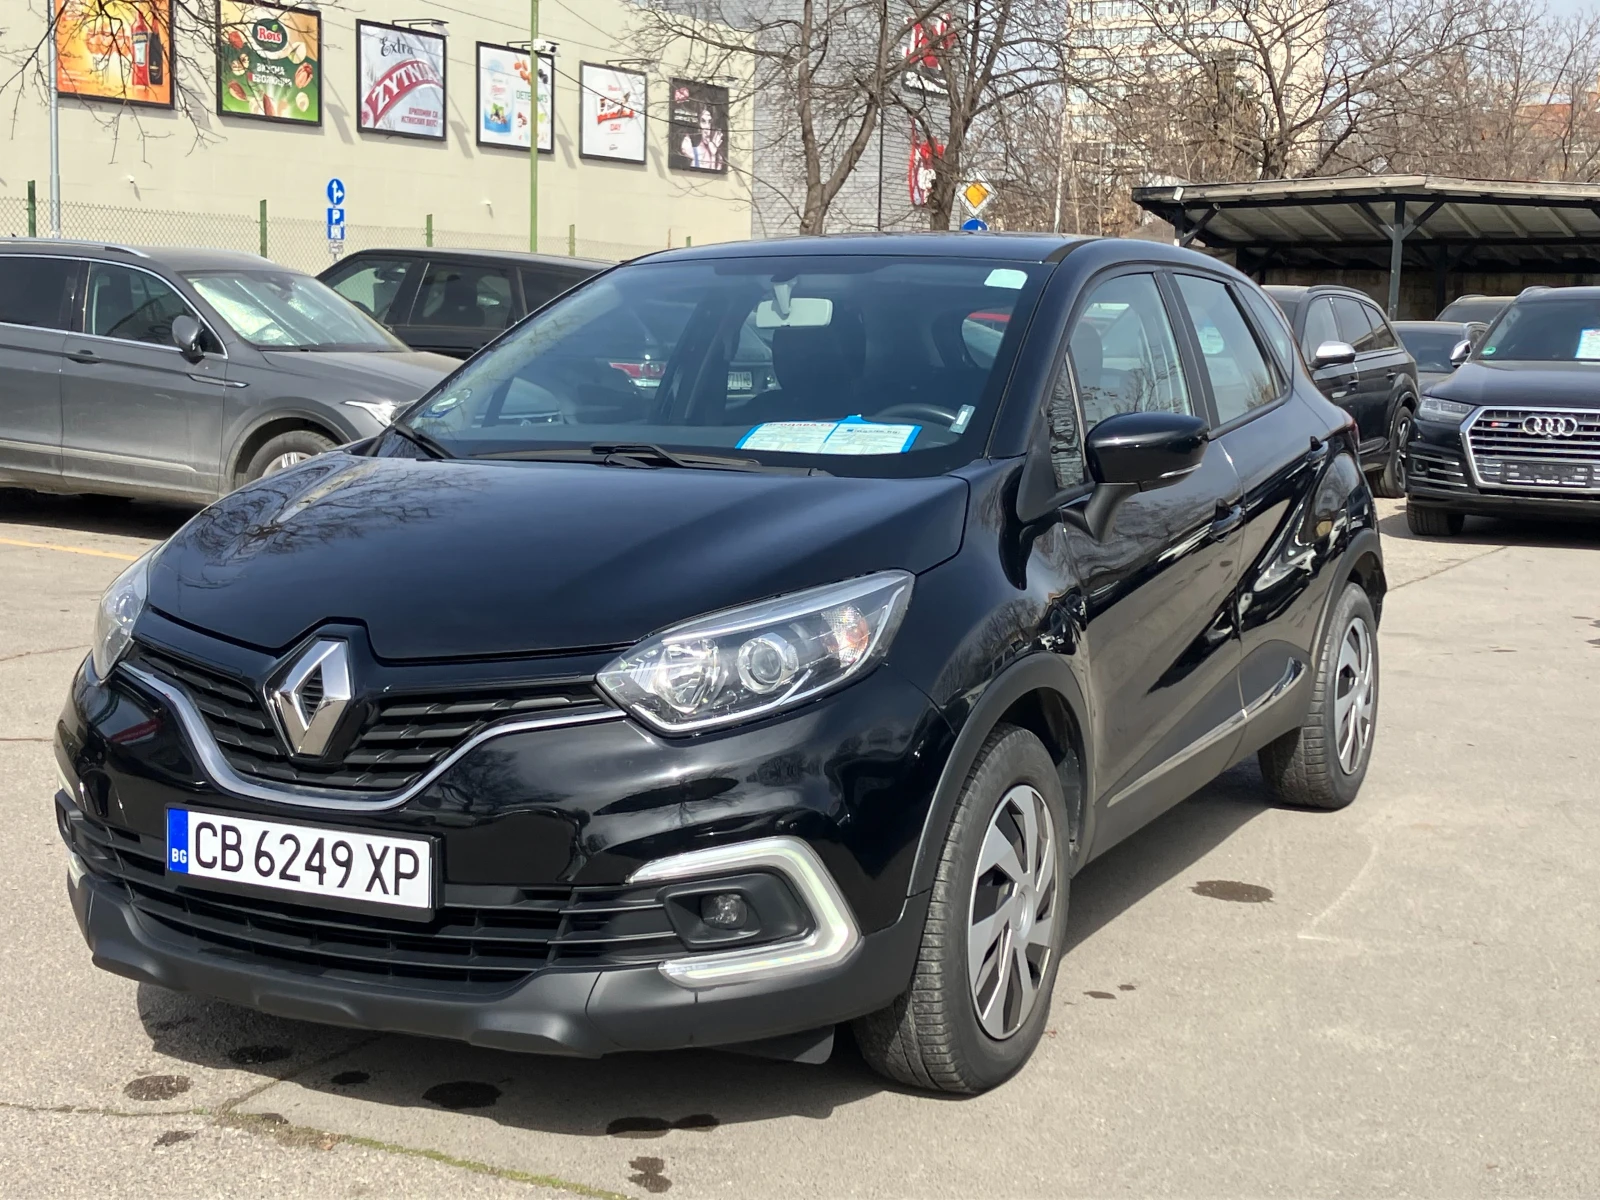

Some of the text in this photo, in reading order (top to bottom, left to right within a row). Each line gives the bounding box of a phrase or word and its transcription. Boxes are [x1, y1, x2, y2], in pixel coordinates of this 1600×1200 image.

[380, 37, 414, 57] Extra
[332, 209, 341, 224] P
[171, 847, 188, 864] BG
[195, 821, 420, 896] CB 6249 XP
